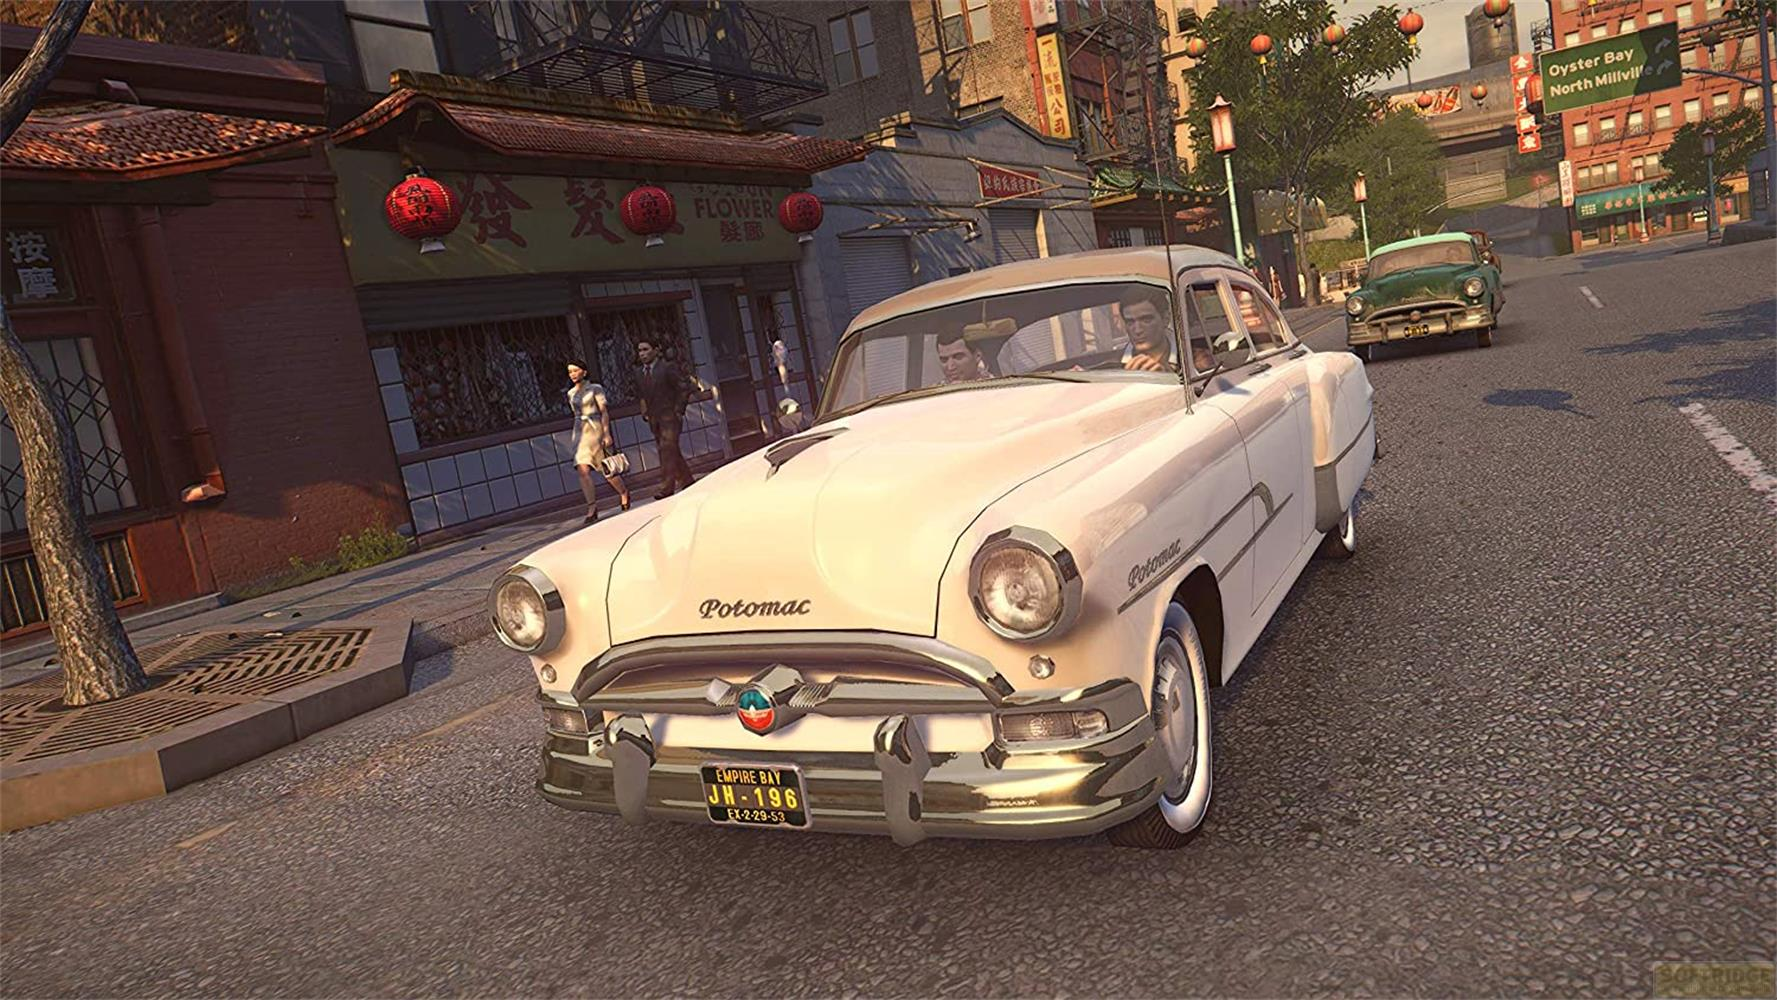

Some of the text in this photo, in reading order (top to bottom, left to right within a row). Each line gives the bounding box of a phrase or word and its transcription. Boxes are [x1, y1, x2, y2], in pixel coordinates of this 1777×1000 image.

[1549, 48, 1634, 77] Oyster Bay
[1550, 78, 1593, 97] North
[694, 199, 774, 219] FLOWER
[6, 231, 58, 298] 按摩
[1127, 538, 1181, 591] Potomac
[698, 598, 812, 619] Potomac
[715, 769, 781, 786] EMPIRE BAY
